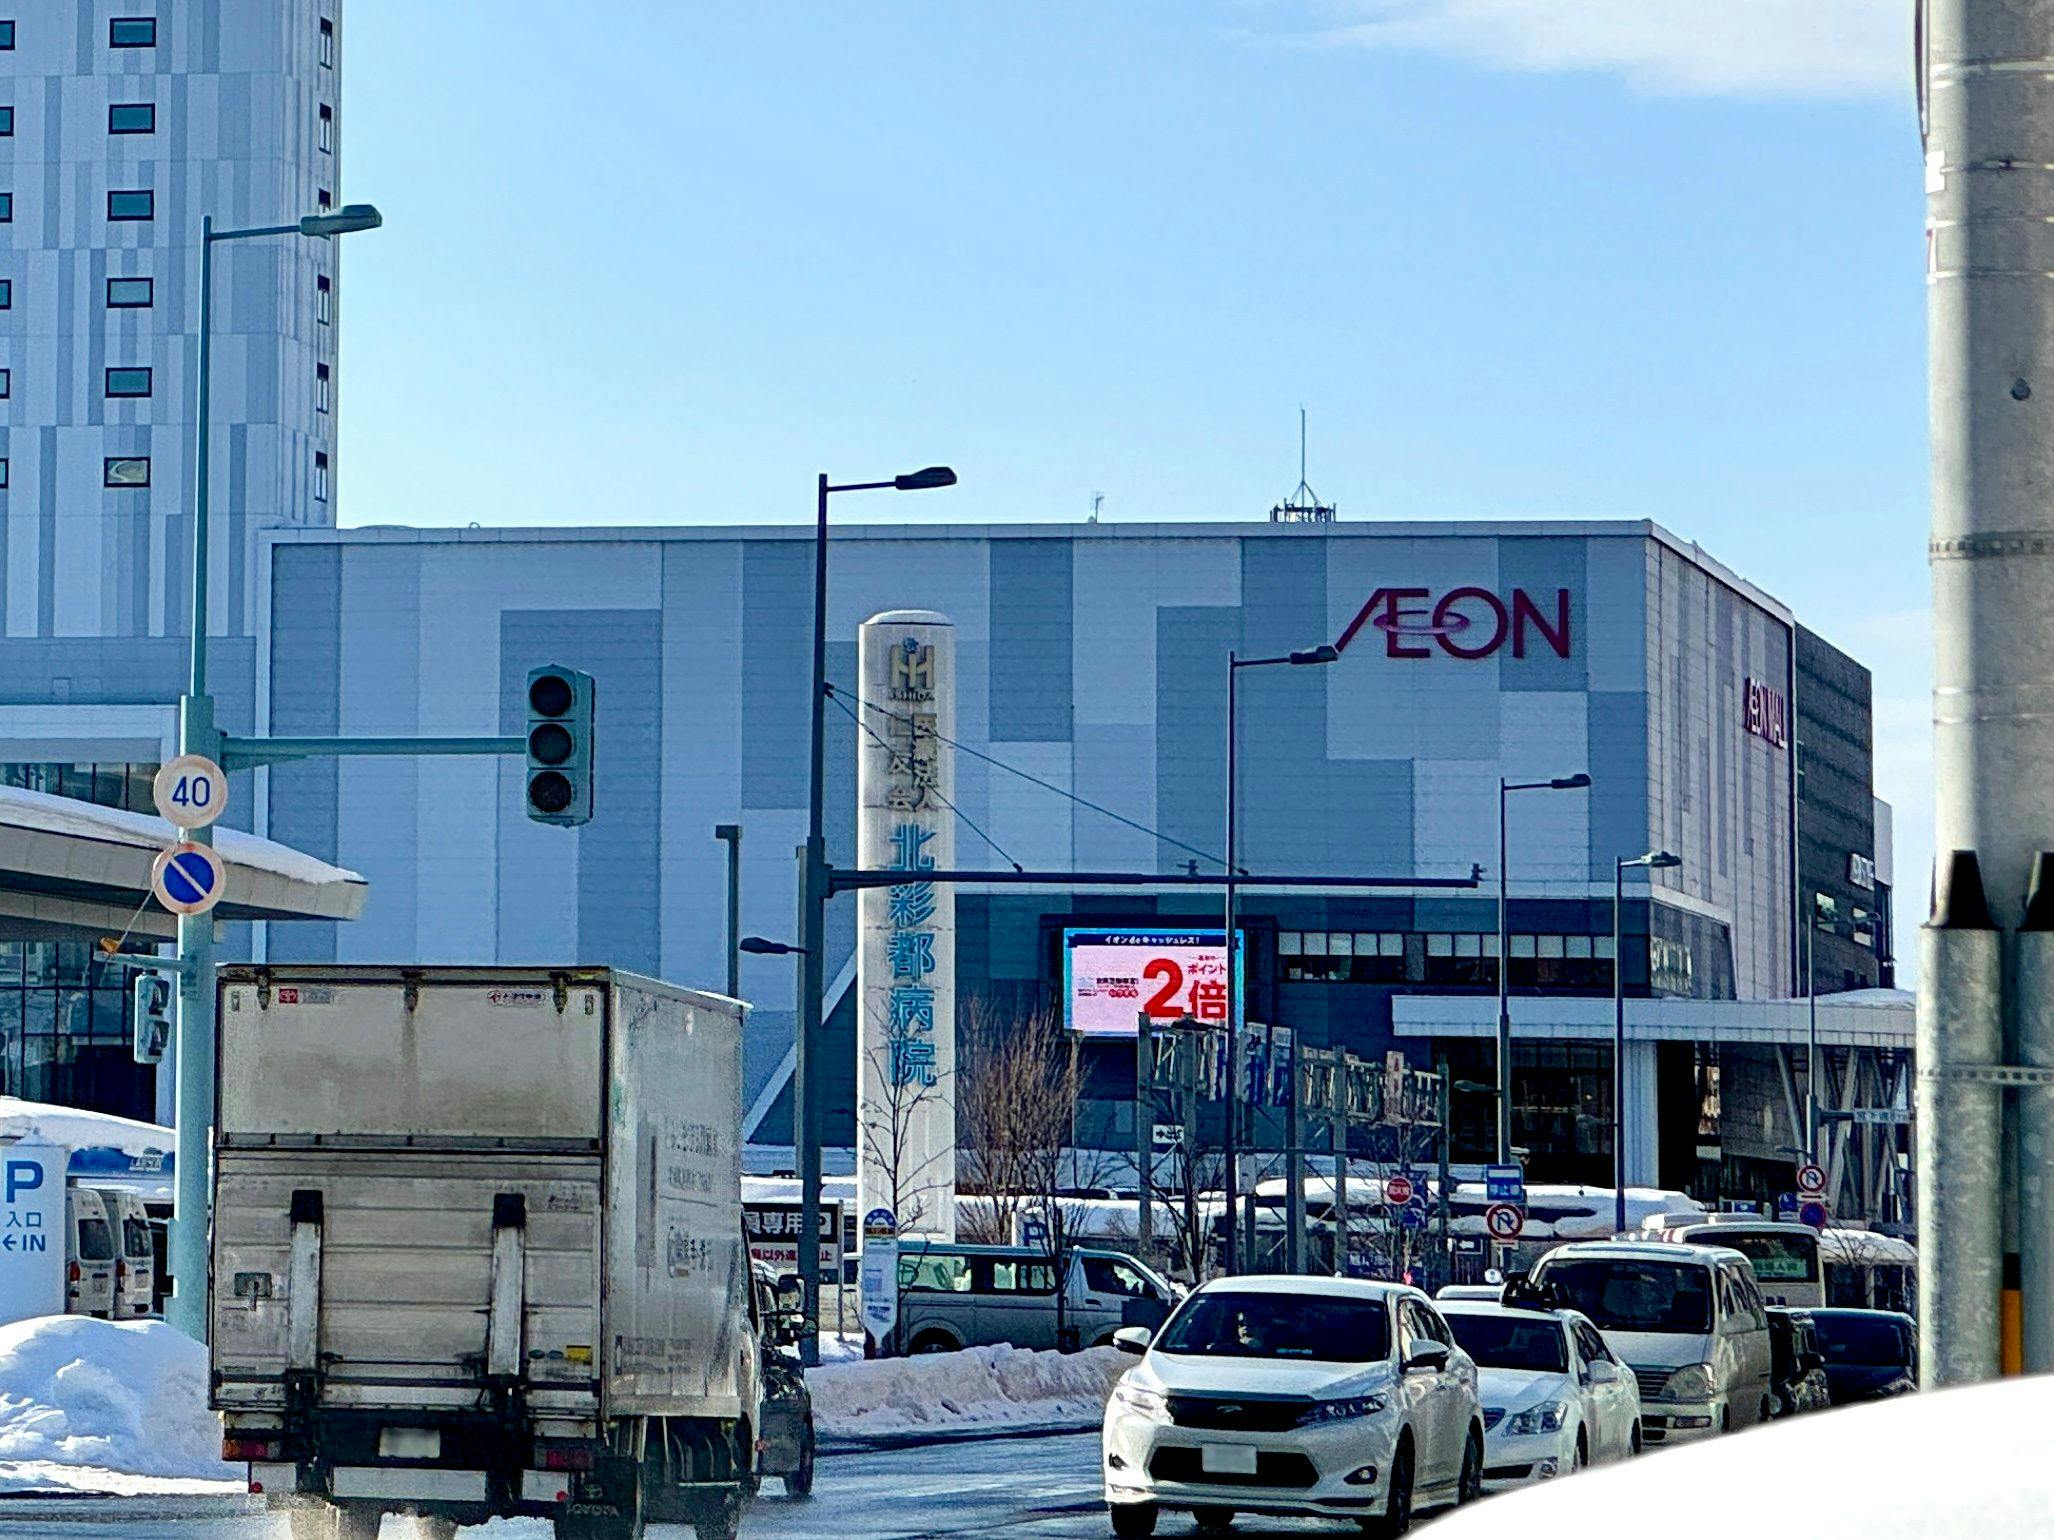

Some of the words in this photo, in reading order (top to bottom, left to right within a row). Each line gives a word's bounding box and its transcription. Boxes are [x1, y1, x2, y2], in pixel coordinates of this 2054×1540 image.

[171, 776, 211, 808] 40
[888, 823, 938, 1088] 北彩都病院
[6, 1160, 44, 1203] P
[6, 1211, 42, 1228] 入口
[22, 1233, 46, 1252] IN
